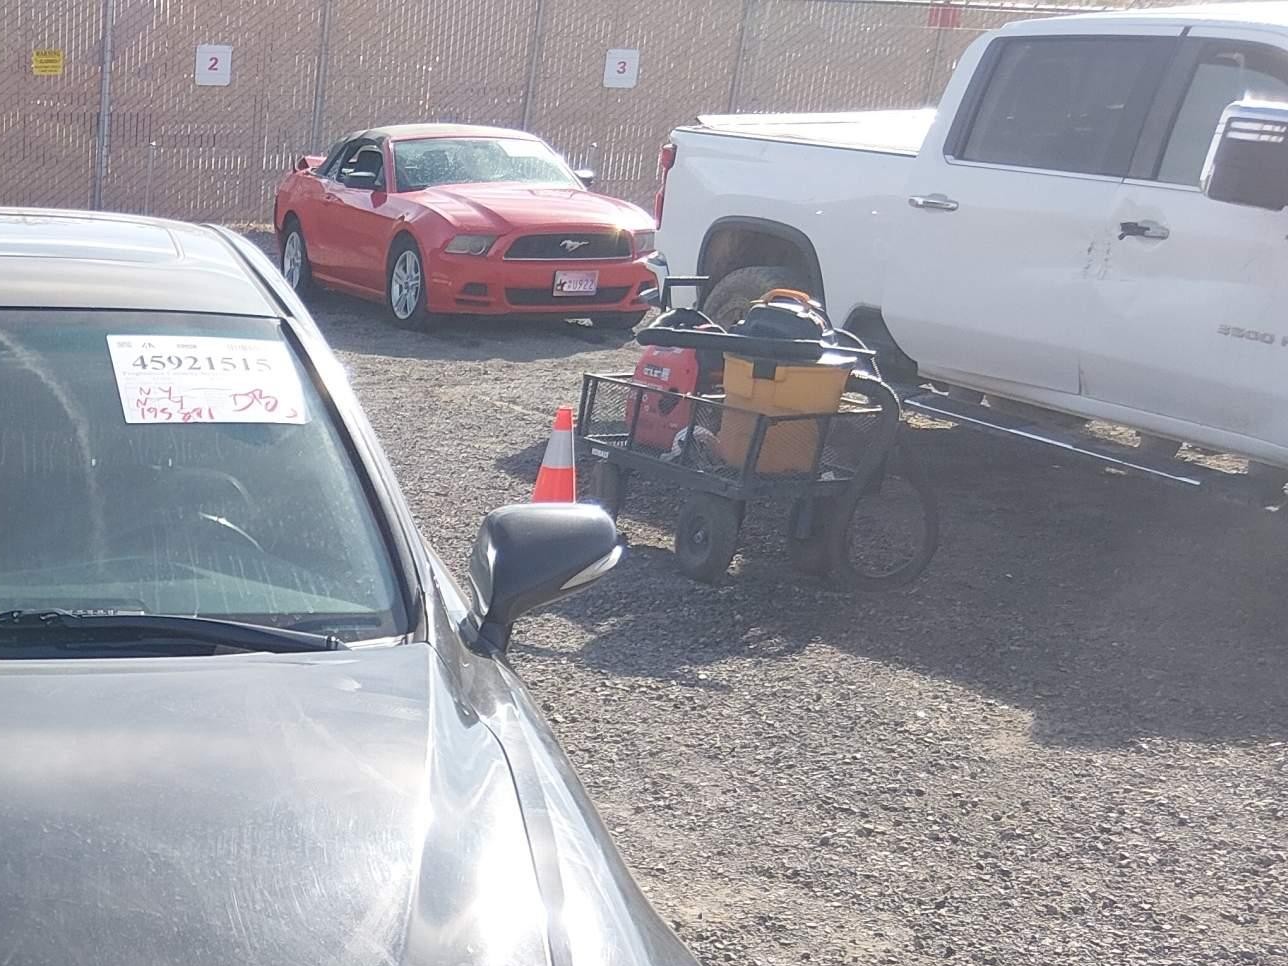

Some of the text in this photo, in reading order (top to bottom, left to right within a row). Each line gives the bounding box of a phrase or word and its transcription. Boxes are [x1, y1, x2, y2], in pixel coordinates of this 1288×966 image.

[207, 56, 219, 71] 2
[616, 61, 627, 74] 3
[131, 354, 272, 373] 45921515
